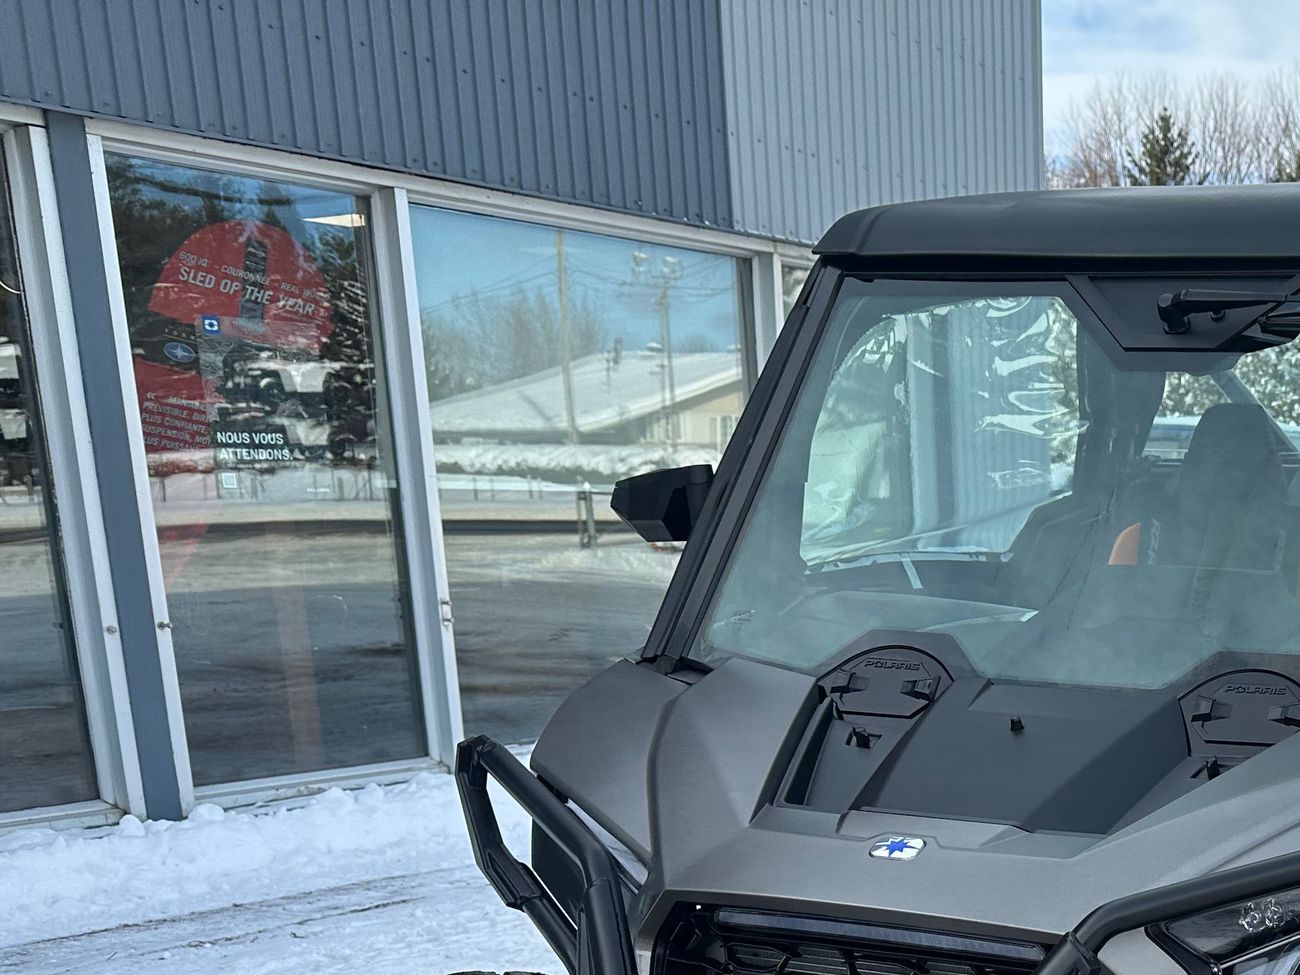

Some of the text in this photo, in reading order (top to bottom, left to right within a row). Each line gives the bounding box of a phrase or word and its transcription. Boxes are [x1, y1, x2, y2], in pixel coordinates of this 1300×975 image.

[178, 266, 216, 289] SLED
[220, 279, 241, 295] OF
[244, 285, 273, 304] THE
[278, 294, 316, 315] YEAR
[216, 431, 284, 445] NOUS VOUS
[219, 449, 293, 461] ATTENDONS.
[863, 659, 921, 671] POLARIS
[1224, 685, 1287, 696] POLARIS
